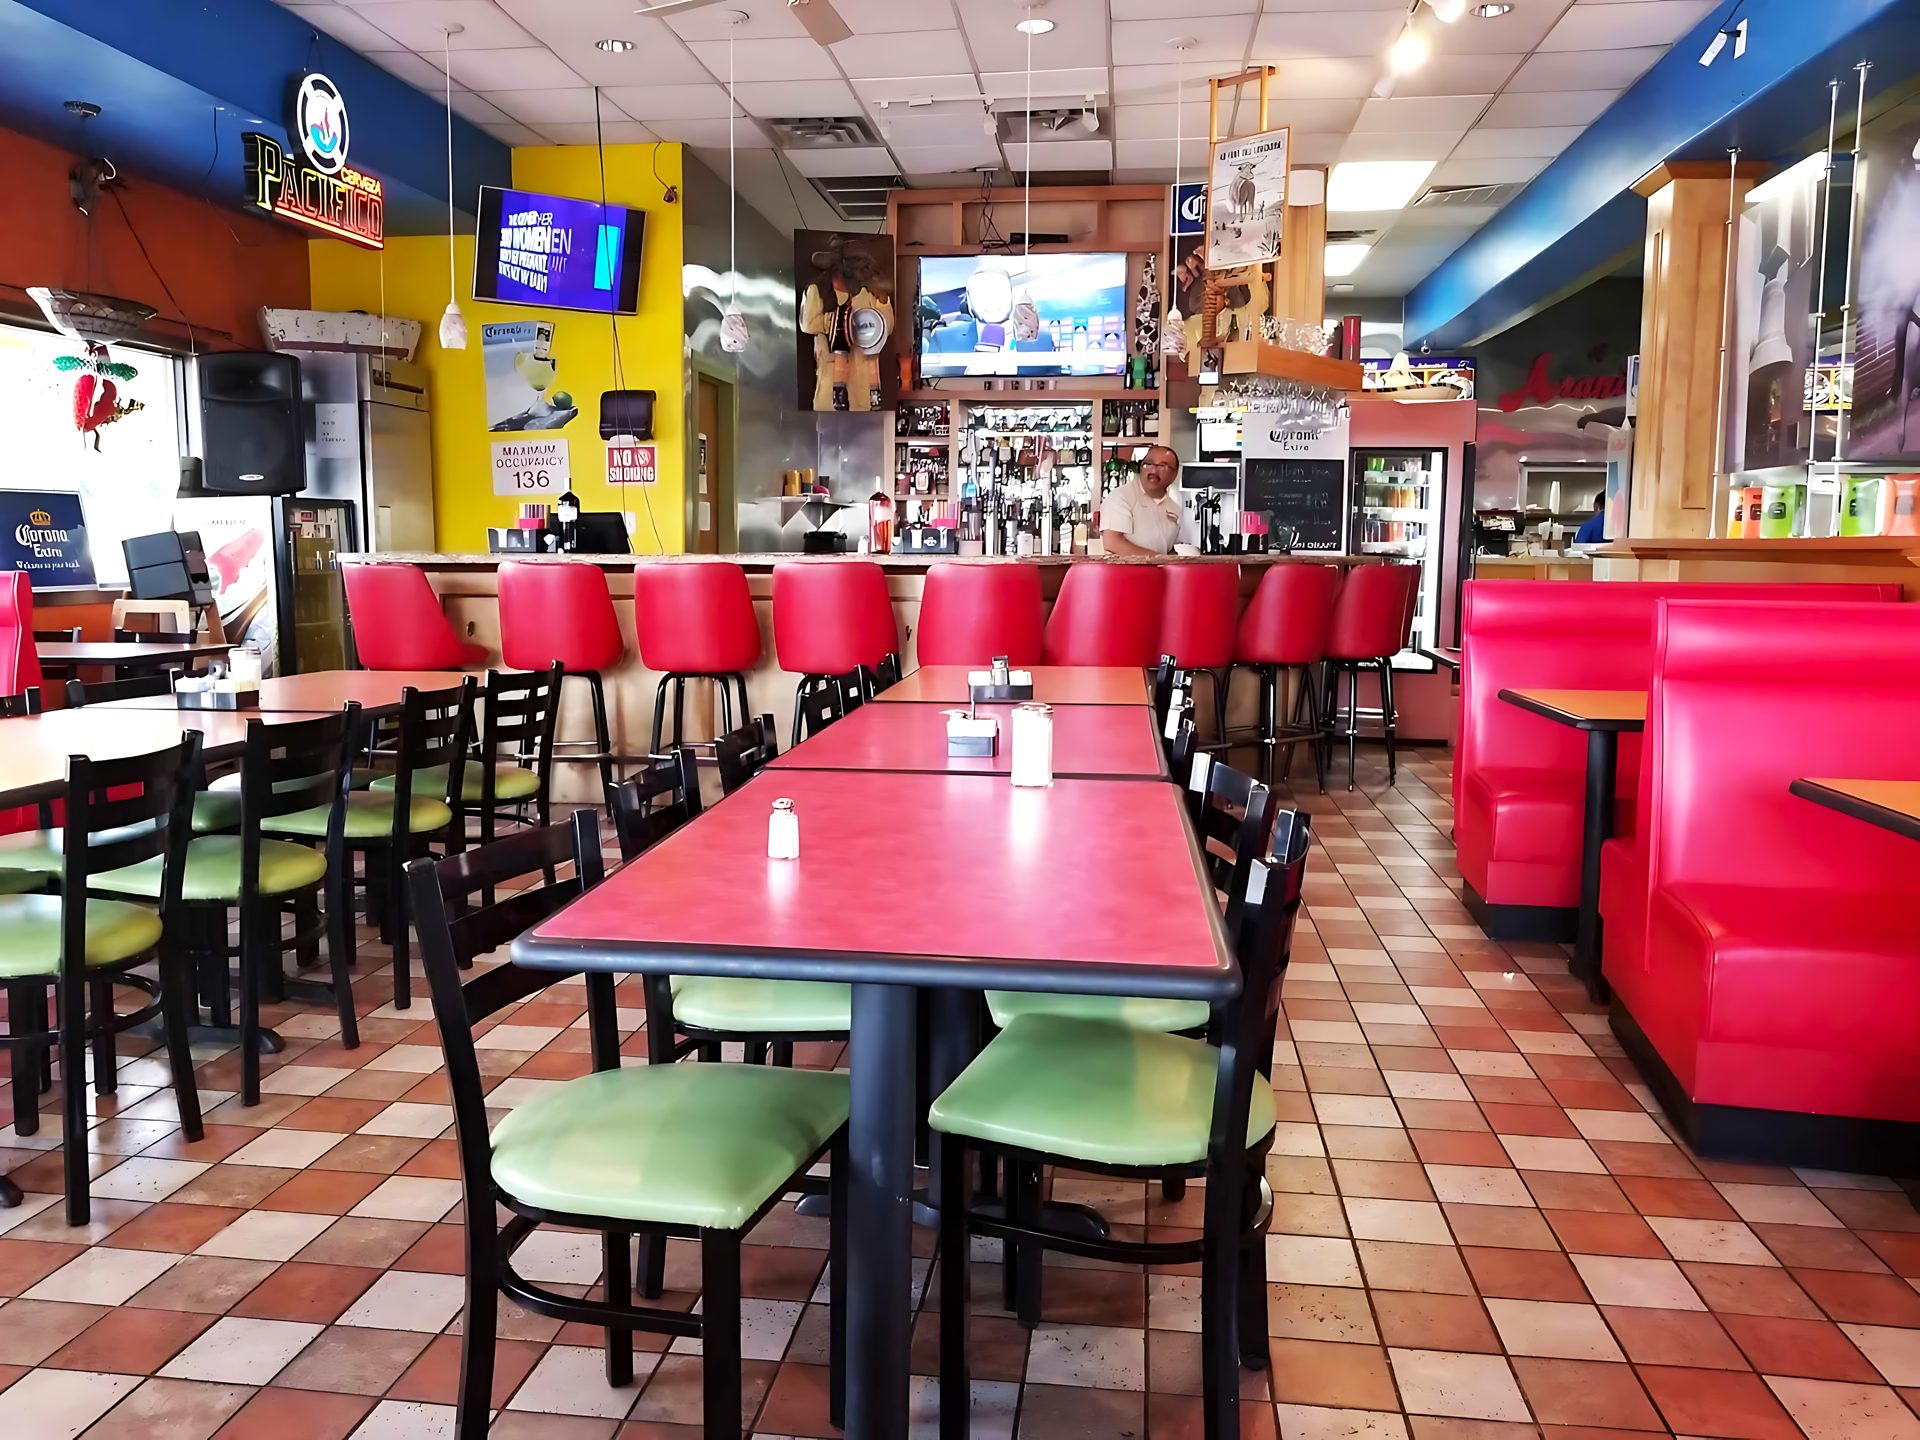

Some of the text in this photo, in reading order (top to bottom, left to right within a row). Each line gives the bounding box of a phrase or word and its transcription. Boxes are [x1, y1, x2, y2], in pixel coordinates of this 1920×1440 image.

[254, 134, 384, 240] PACIFICO
[341, 167, 381, 196] CERVEZA
[502, 445, 556, 456] MAXIMUM
[613, 449, 632, 467] NO
[496, 456, 563, 468] OCCUPANCY
[513, 469, 550, 489] 136
[609, 466, 654, 482] SMOKING
[15, 523, 68, 548] Corona
